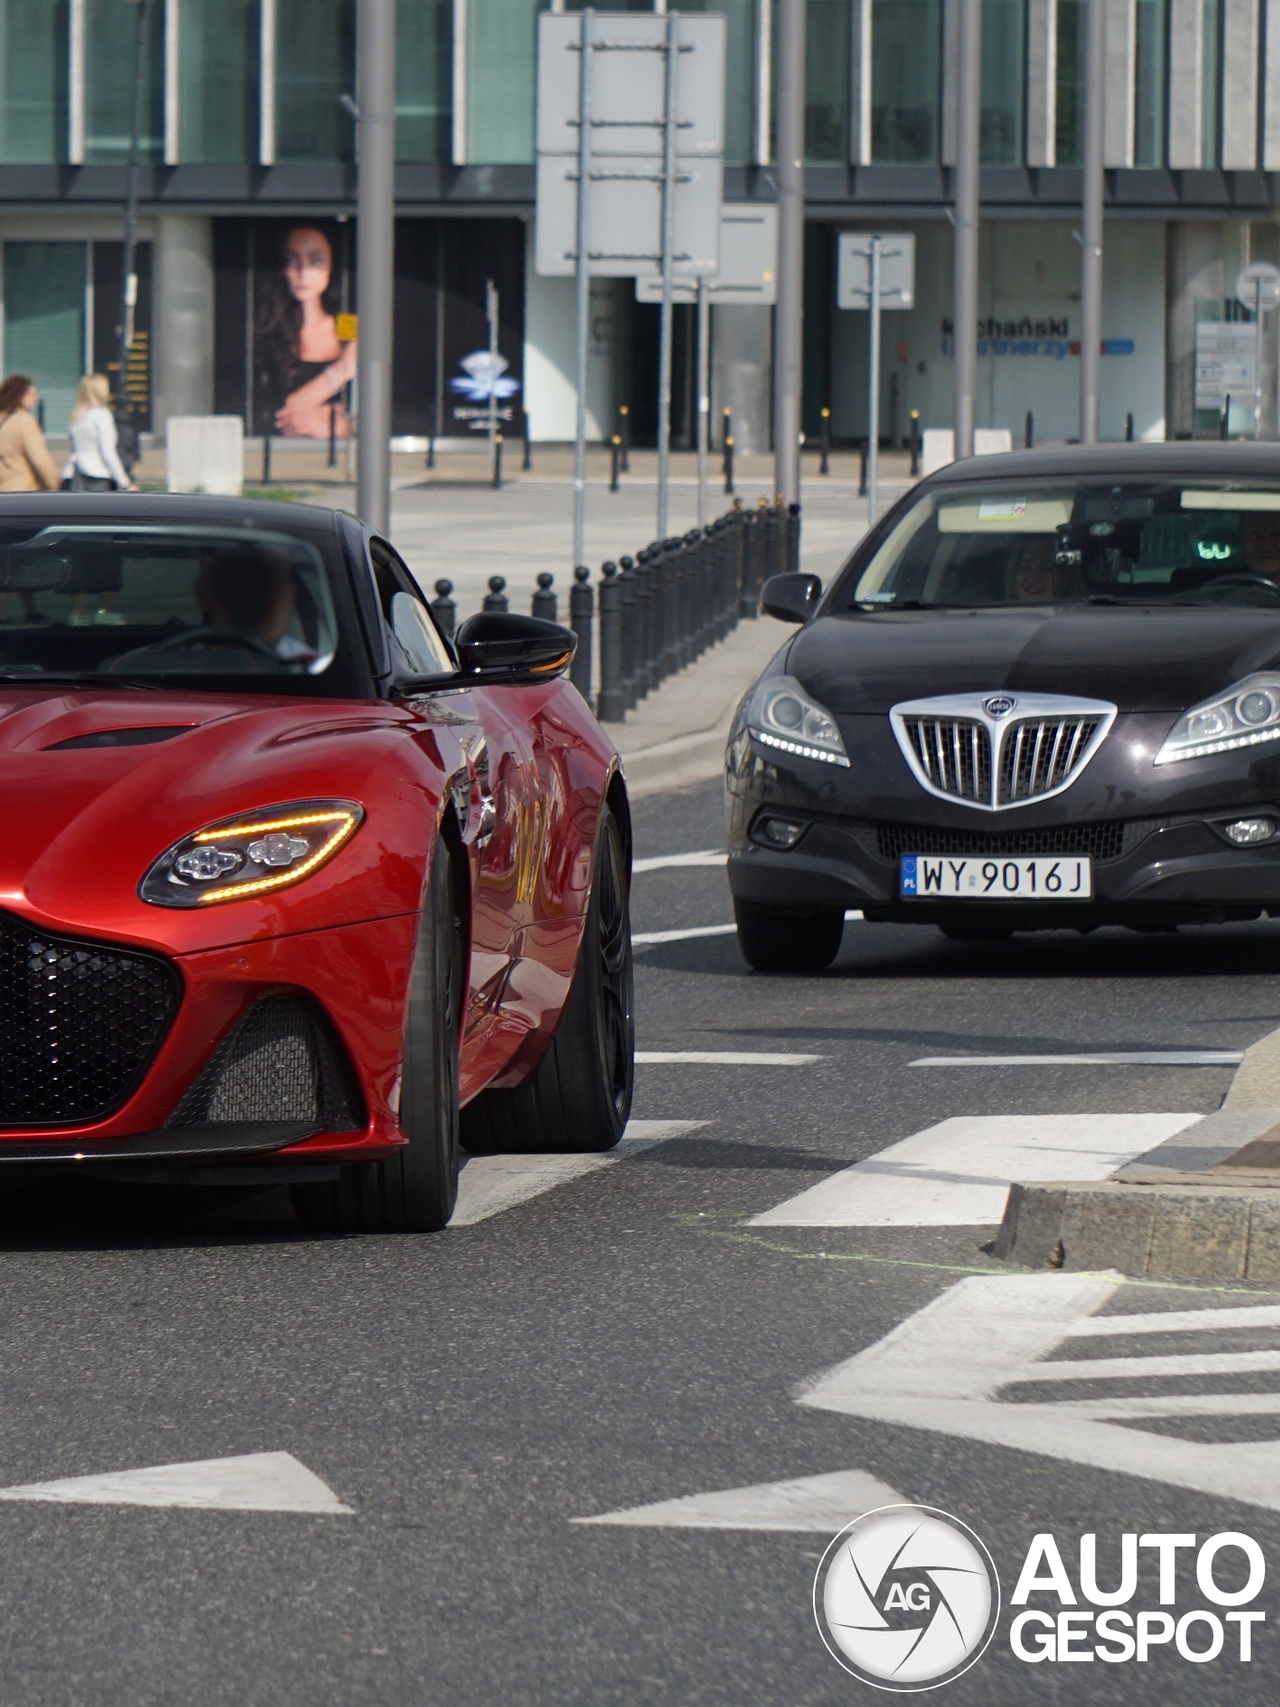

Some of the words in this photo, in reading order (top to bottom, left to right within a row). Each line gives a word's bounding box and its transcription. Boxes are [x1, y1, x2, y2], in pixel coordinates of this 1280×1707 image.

[904, 879, 916, 888] PL
[923, 861, 967, 891] WY
[982, 861, 1082, 892] 9016J
